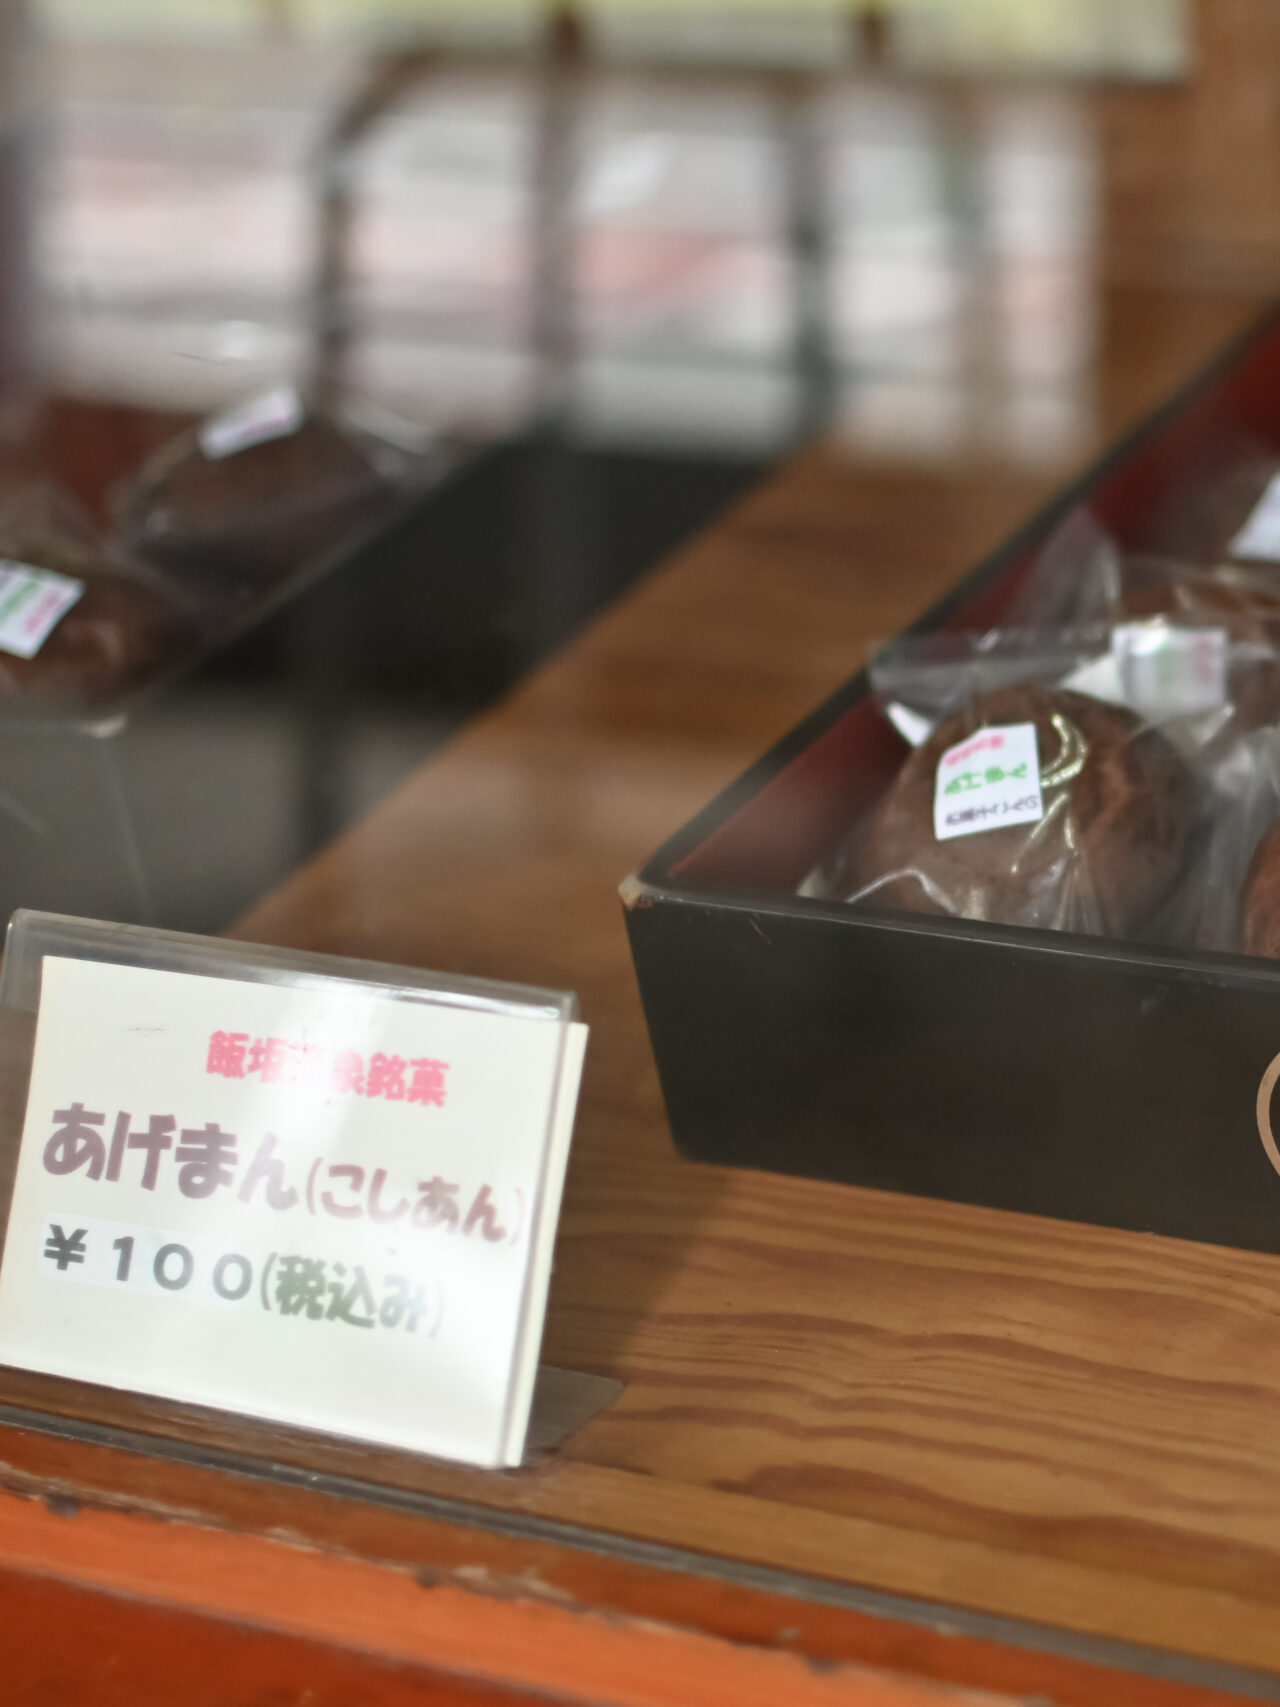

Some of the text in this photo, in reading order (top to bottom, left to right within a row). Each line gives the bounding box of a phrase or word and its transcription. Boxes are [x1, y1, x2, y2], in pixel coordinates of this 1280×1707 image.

[206, 1030, 450, 1107] 飯坂泉銘菓
